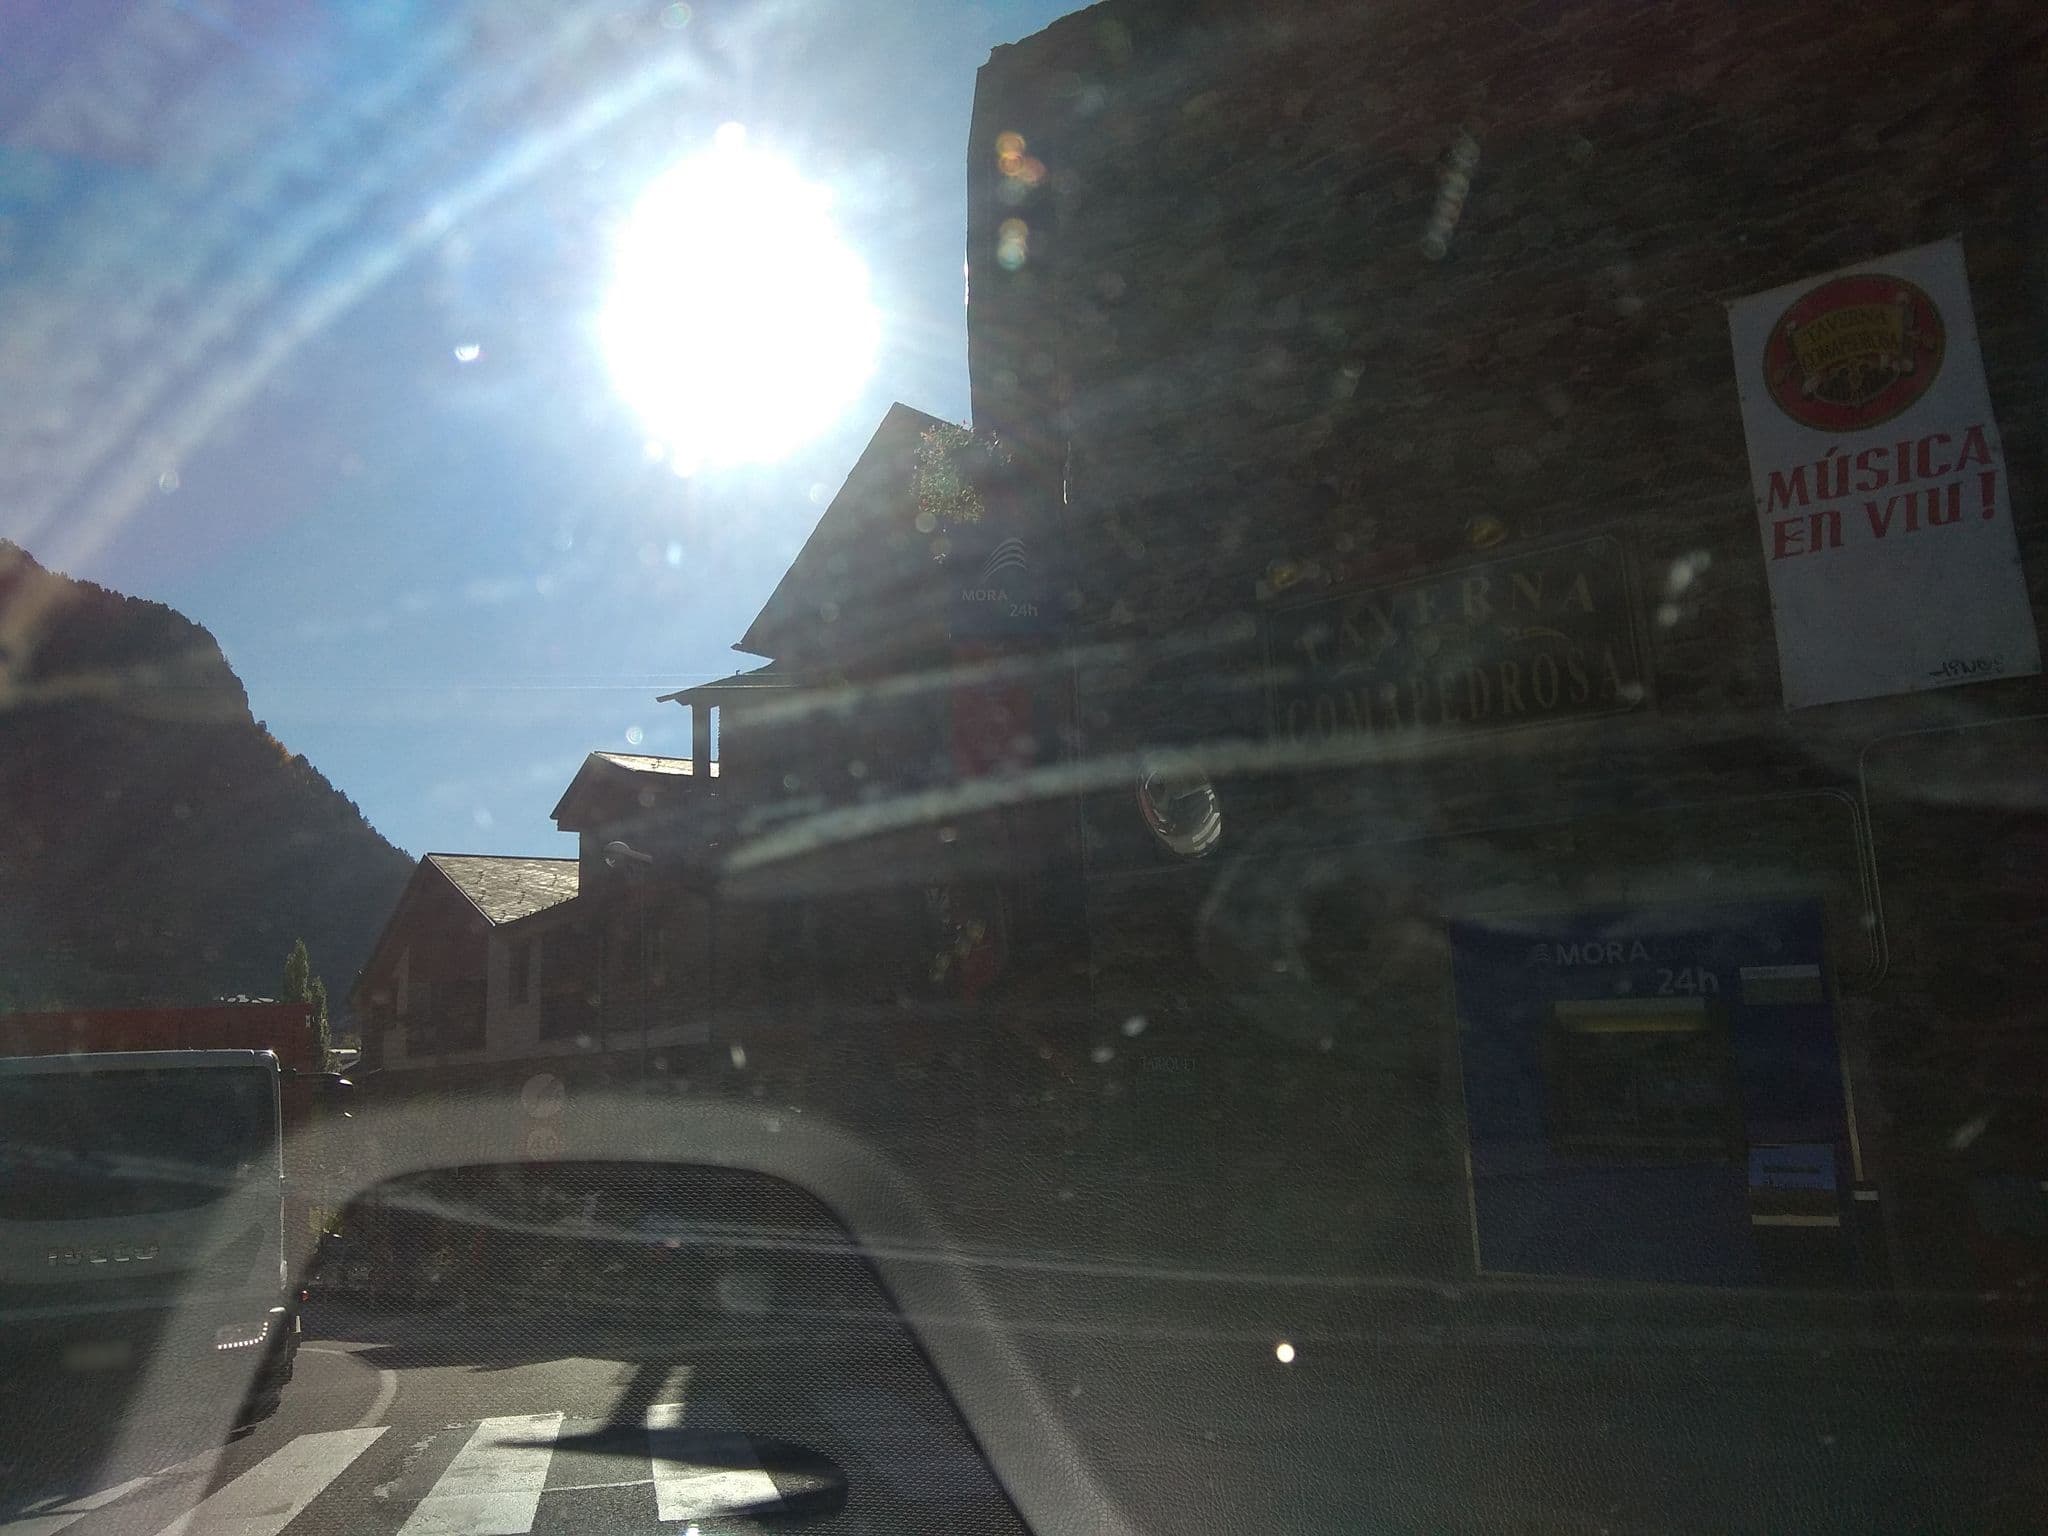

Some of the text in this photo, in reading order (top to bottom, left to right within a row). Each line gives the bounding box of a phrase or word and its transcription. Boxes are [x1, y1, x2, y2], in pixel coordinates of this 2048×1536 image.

[1767, 424, 1995, 514] MÚSICA
[961, 589, 1008, 601] MORA
[1009, 602, 1040, 617] 24h
[1293, 570, 1596, 666] TAVERNA
[1556, 940, 1651, 965] MORA
[1656, 966, 1720, 996] 24h
